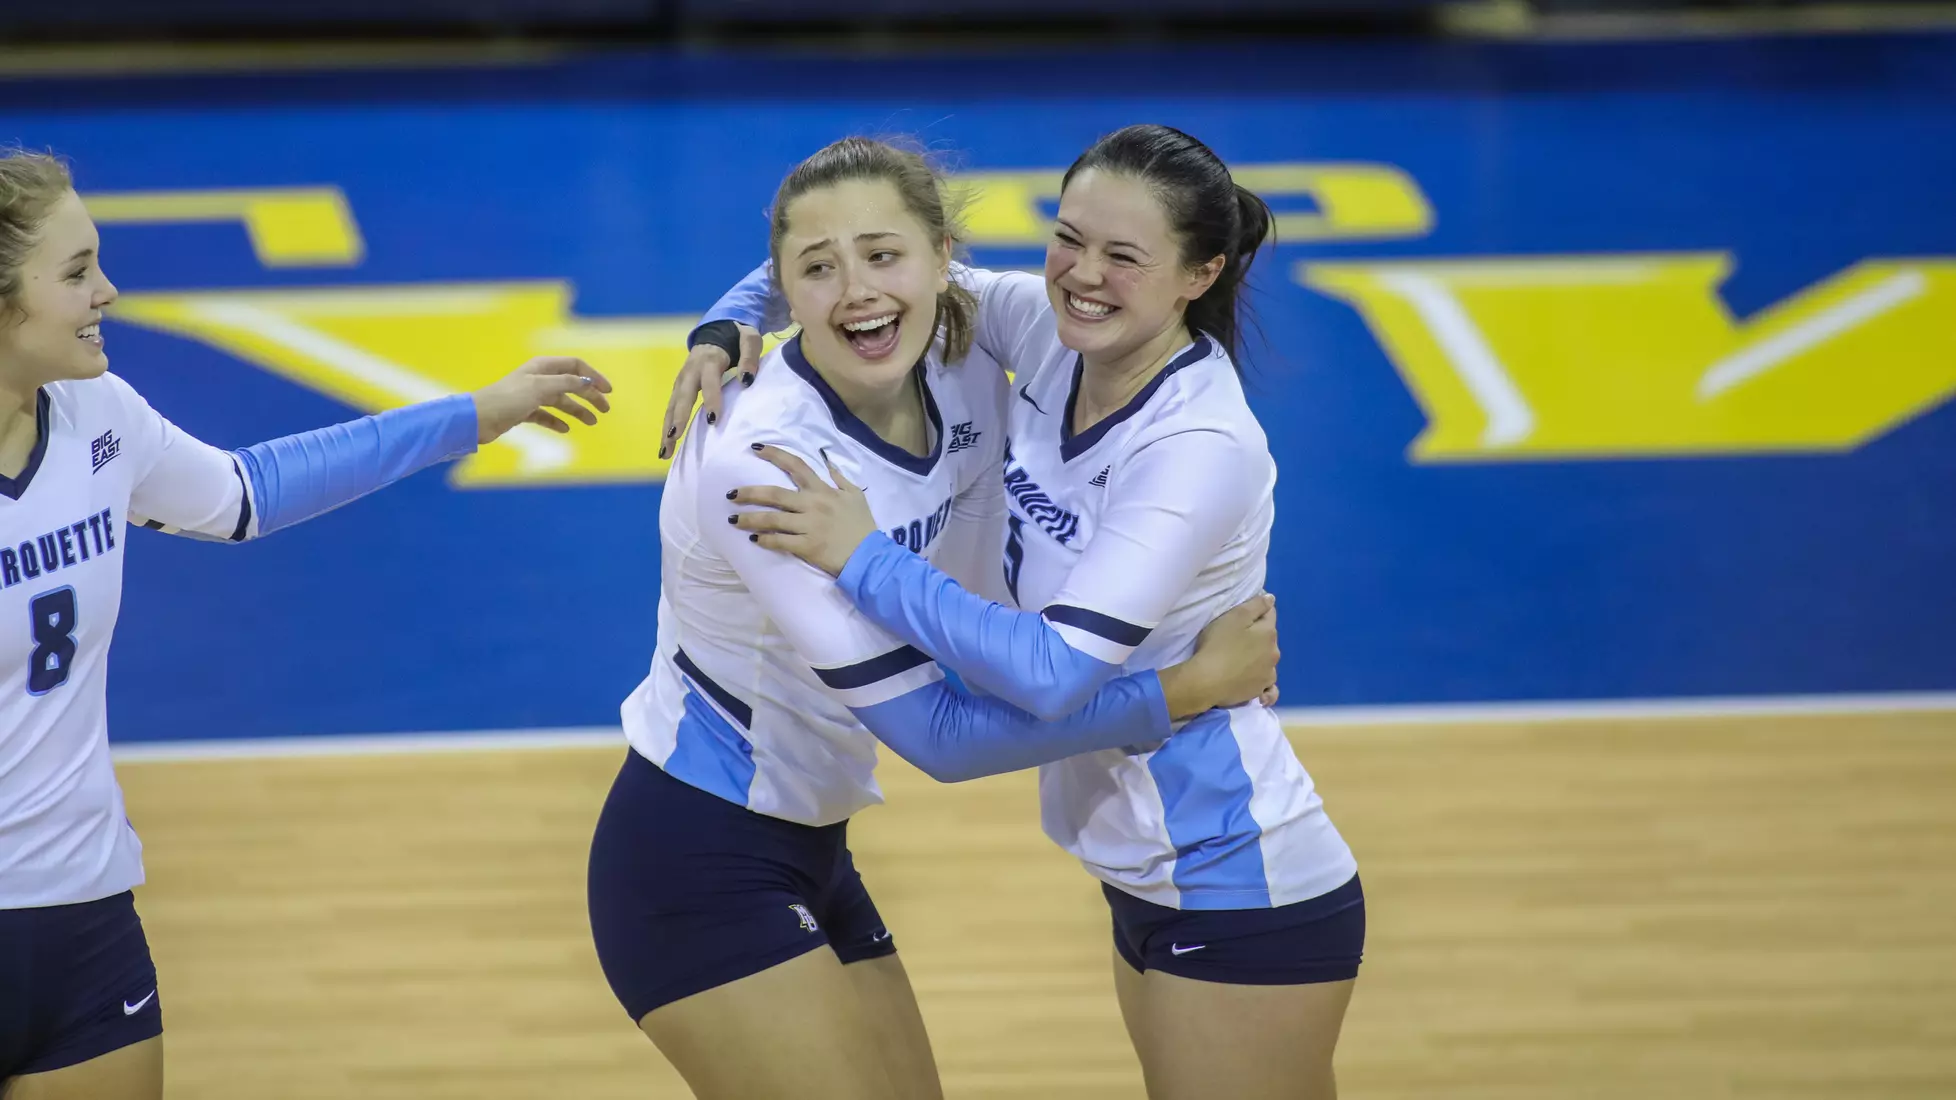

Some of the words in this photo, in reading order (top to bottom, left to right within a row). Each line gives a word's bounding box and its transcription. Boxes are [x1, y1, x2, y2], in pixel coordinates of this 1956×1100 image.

[91, 429, 112, 455] BIG
[92, 437, 121, 468] EAST
[0, 506, 115, 590] RQUETTE
[26, 584, 78, 697] 8
